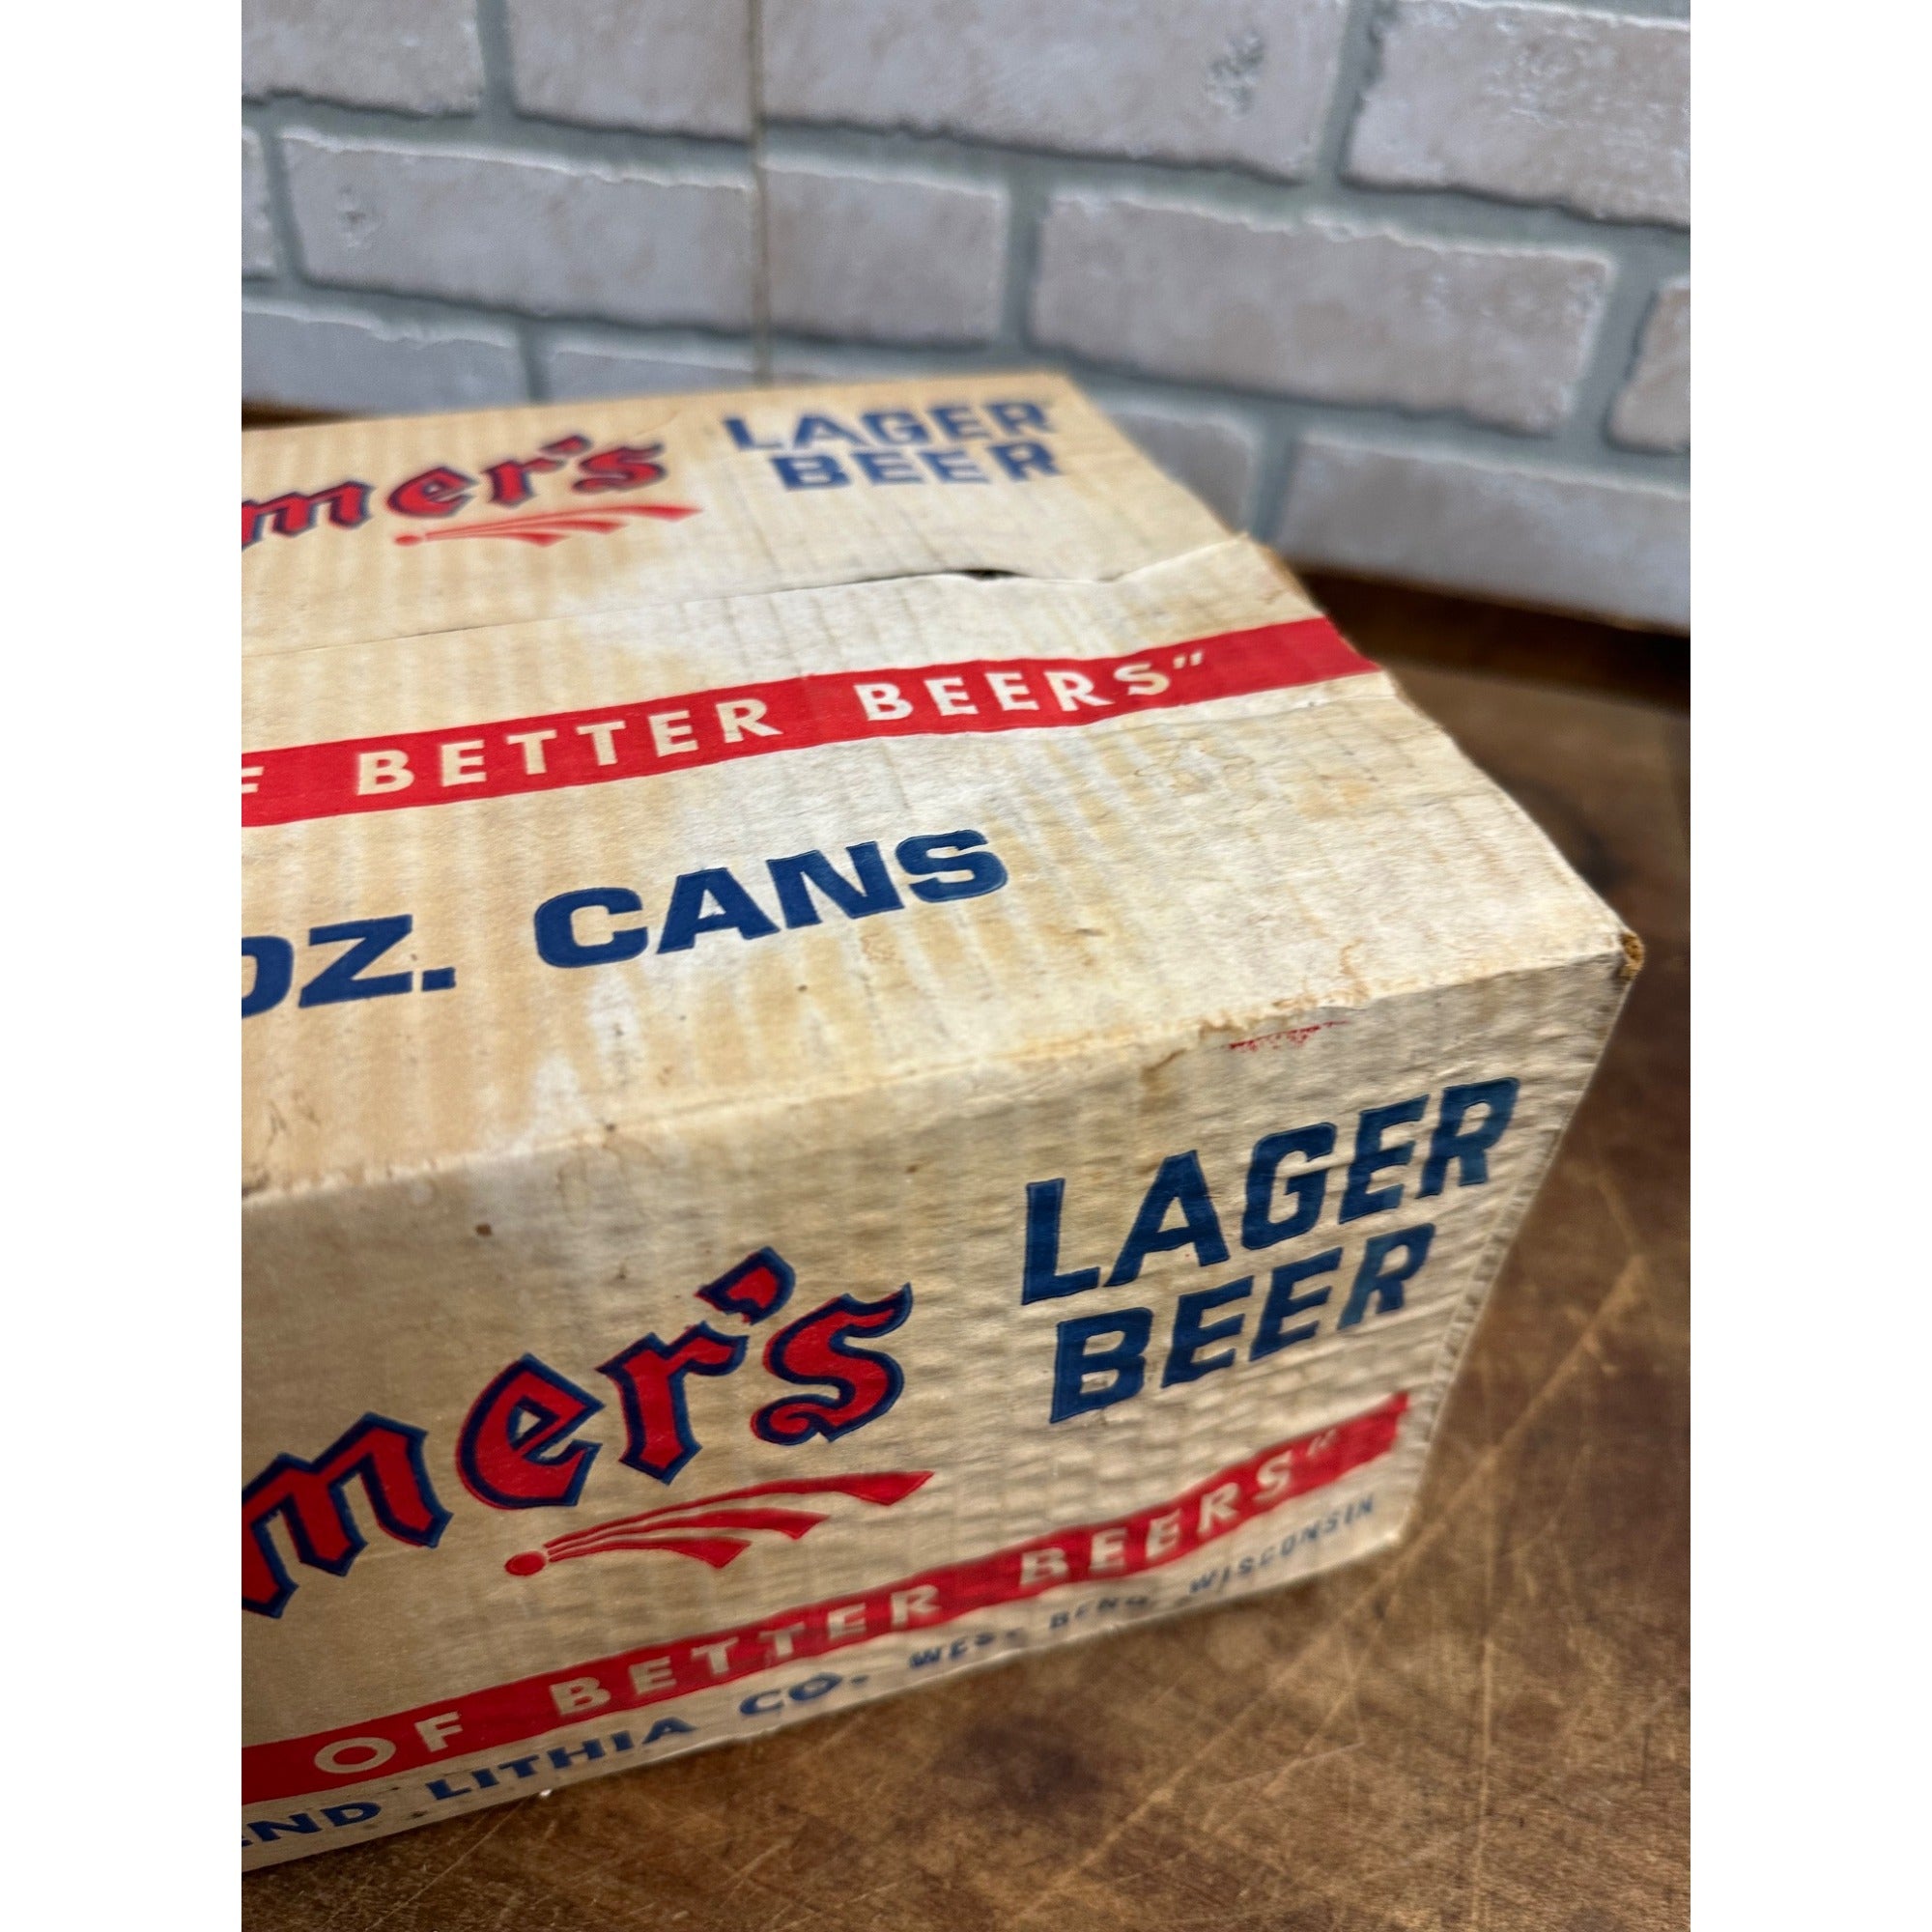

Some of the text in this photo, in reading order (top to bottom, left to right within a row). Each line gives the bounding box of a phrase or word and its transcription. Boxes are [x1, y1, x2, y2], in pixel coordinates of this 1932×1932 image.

[721, 400, 1058, 451] LAGER
[767, 440, 1064, 492] BEER
[356, 696, 782, 796] BETTER
[533, 829, 1009, 968] CANS
[1021, 1077, 1520, 1306] LAGER
[1049, 1222, 1435, 1424] BEER
[314, 1711, 464, 1776] OF
[548, 1584, 943, 1717] BETTER
[242, 1801, 382, 1847] ND
[425, 1717, 698, 1801] LITHIA
[739, 1671, 869, 1716] CO.
